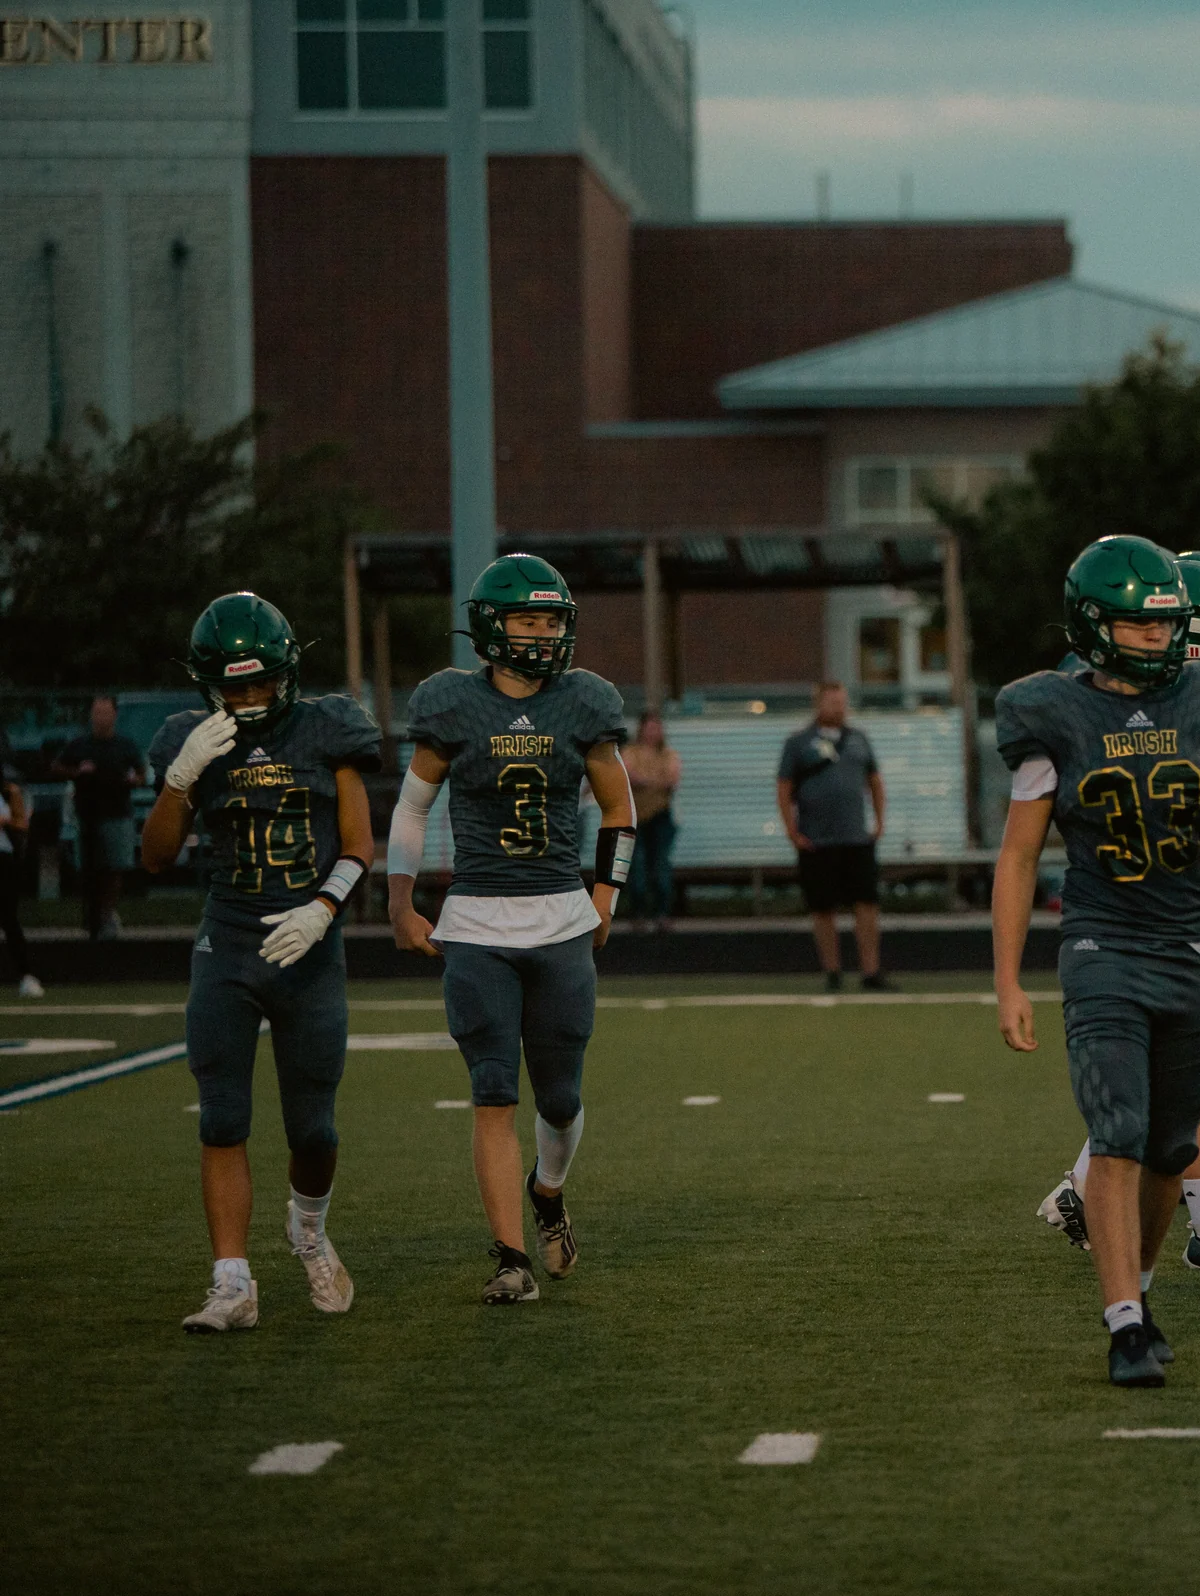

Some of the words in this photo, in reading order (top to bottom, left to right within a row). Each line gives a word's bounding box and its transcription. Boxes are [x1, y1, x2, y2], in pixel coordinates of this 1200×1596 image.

[534, 592, 560, 600] Riddell
[1149, 598, 1177, 606] Riddell
[228, 662, 258, 673] Riddell
[509, 723, 536, 731] adidas
[1126, 719, 1154, 728] adidas
[490, 734, 554, 757] IRISH
[1103, 729, 1177, 759] IRISH
[497, 763, 549, 860] 3
[224, 787, 319, 894] 14
